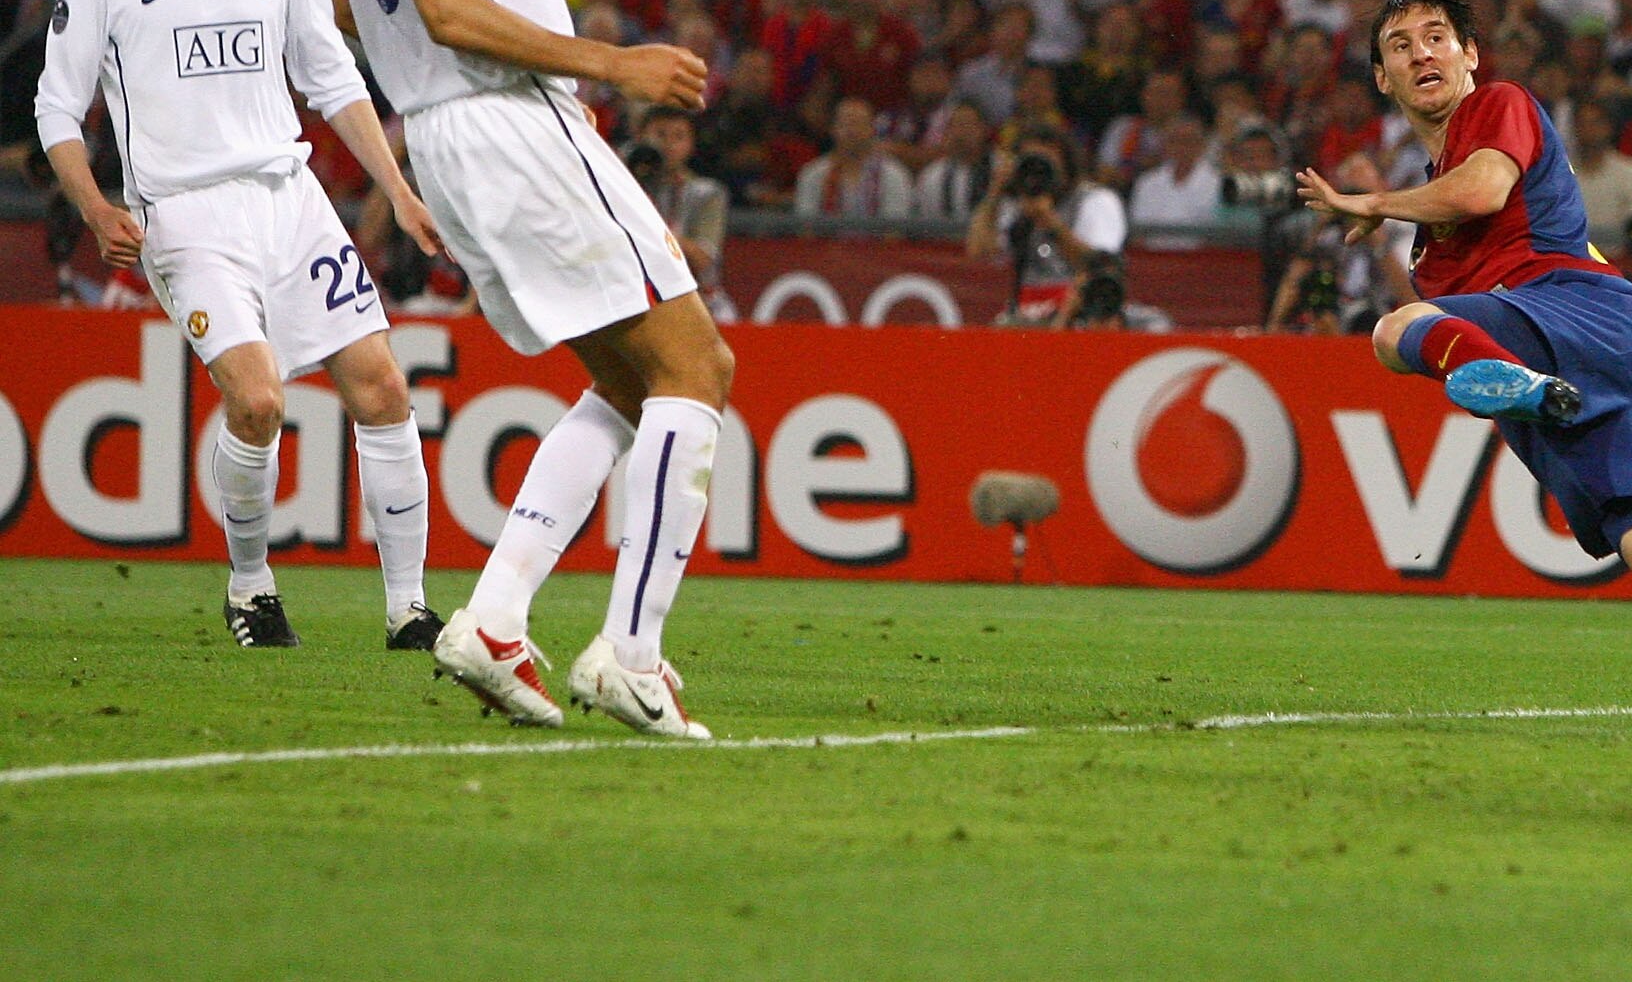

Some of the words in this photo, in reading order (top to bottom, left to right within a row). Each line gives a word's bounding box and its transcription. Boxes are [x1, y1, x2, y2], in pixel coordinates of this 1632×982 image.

[185, 27, 261, 71] AIG
[310, 244, 375, 312] 22
[513, 506, 557, 529] MUFC
